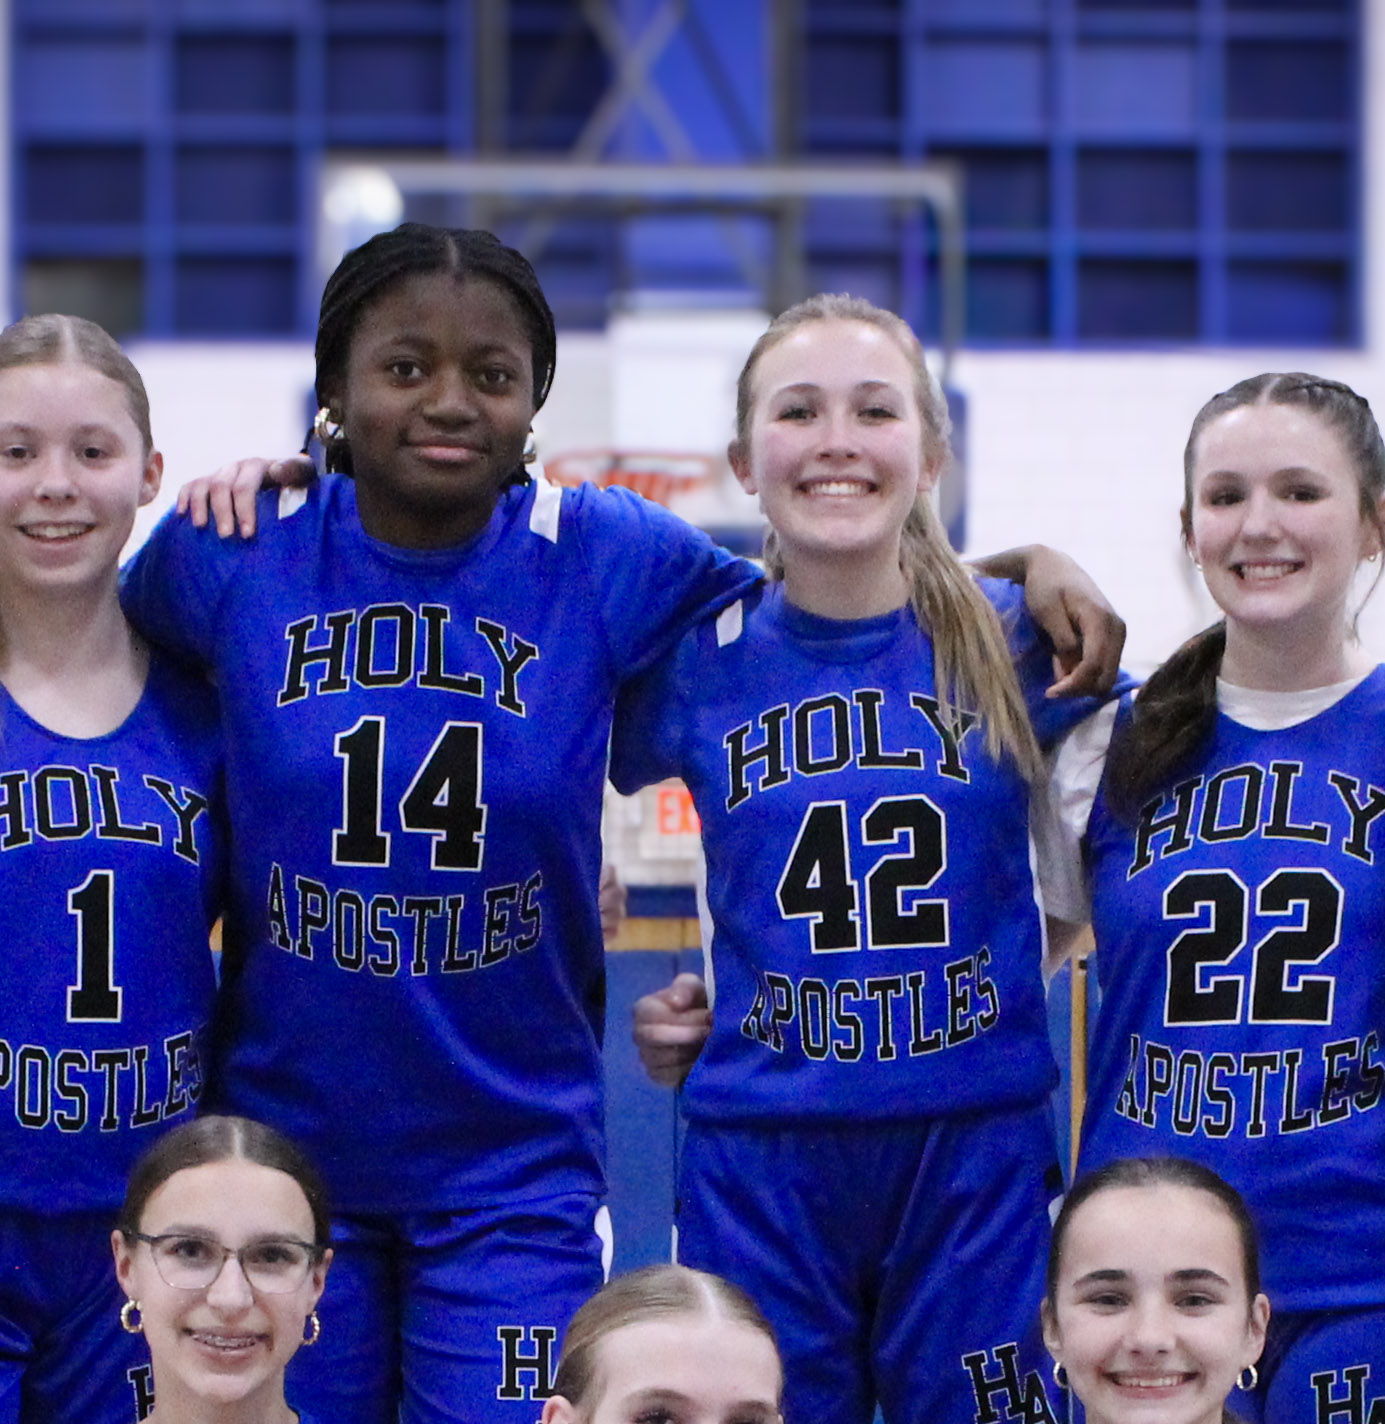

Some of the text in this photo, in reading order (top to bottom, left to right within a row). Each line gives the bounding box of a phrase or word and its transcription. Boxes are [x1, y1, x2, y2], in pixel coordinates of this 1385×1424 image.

[277, 602, 539, 718] HOLY
[332, 715, 488, 872] 14
[723, 688, 982, 813] HOLY
[269, 861, 543, 977] APOSTLES
[775, 794, 950, 954] 42
[66, 869, 123, 1024] 1
[740, 945, 1001, 1062] APOSTLES
[1162, 867, 1345, 1027] 22
